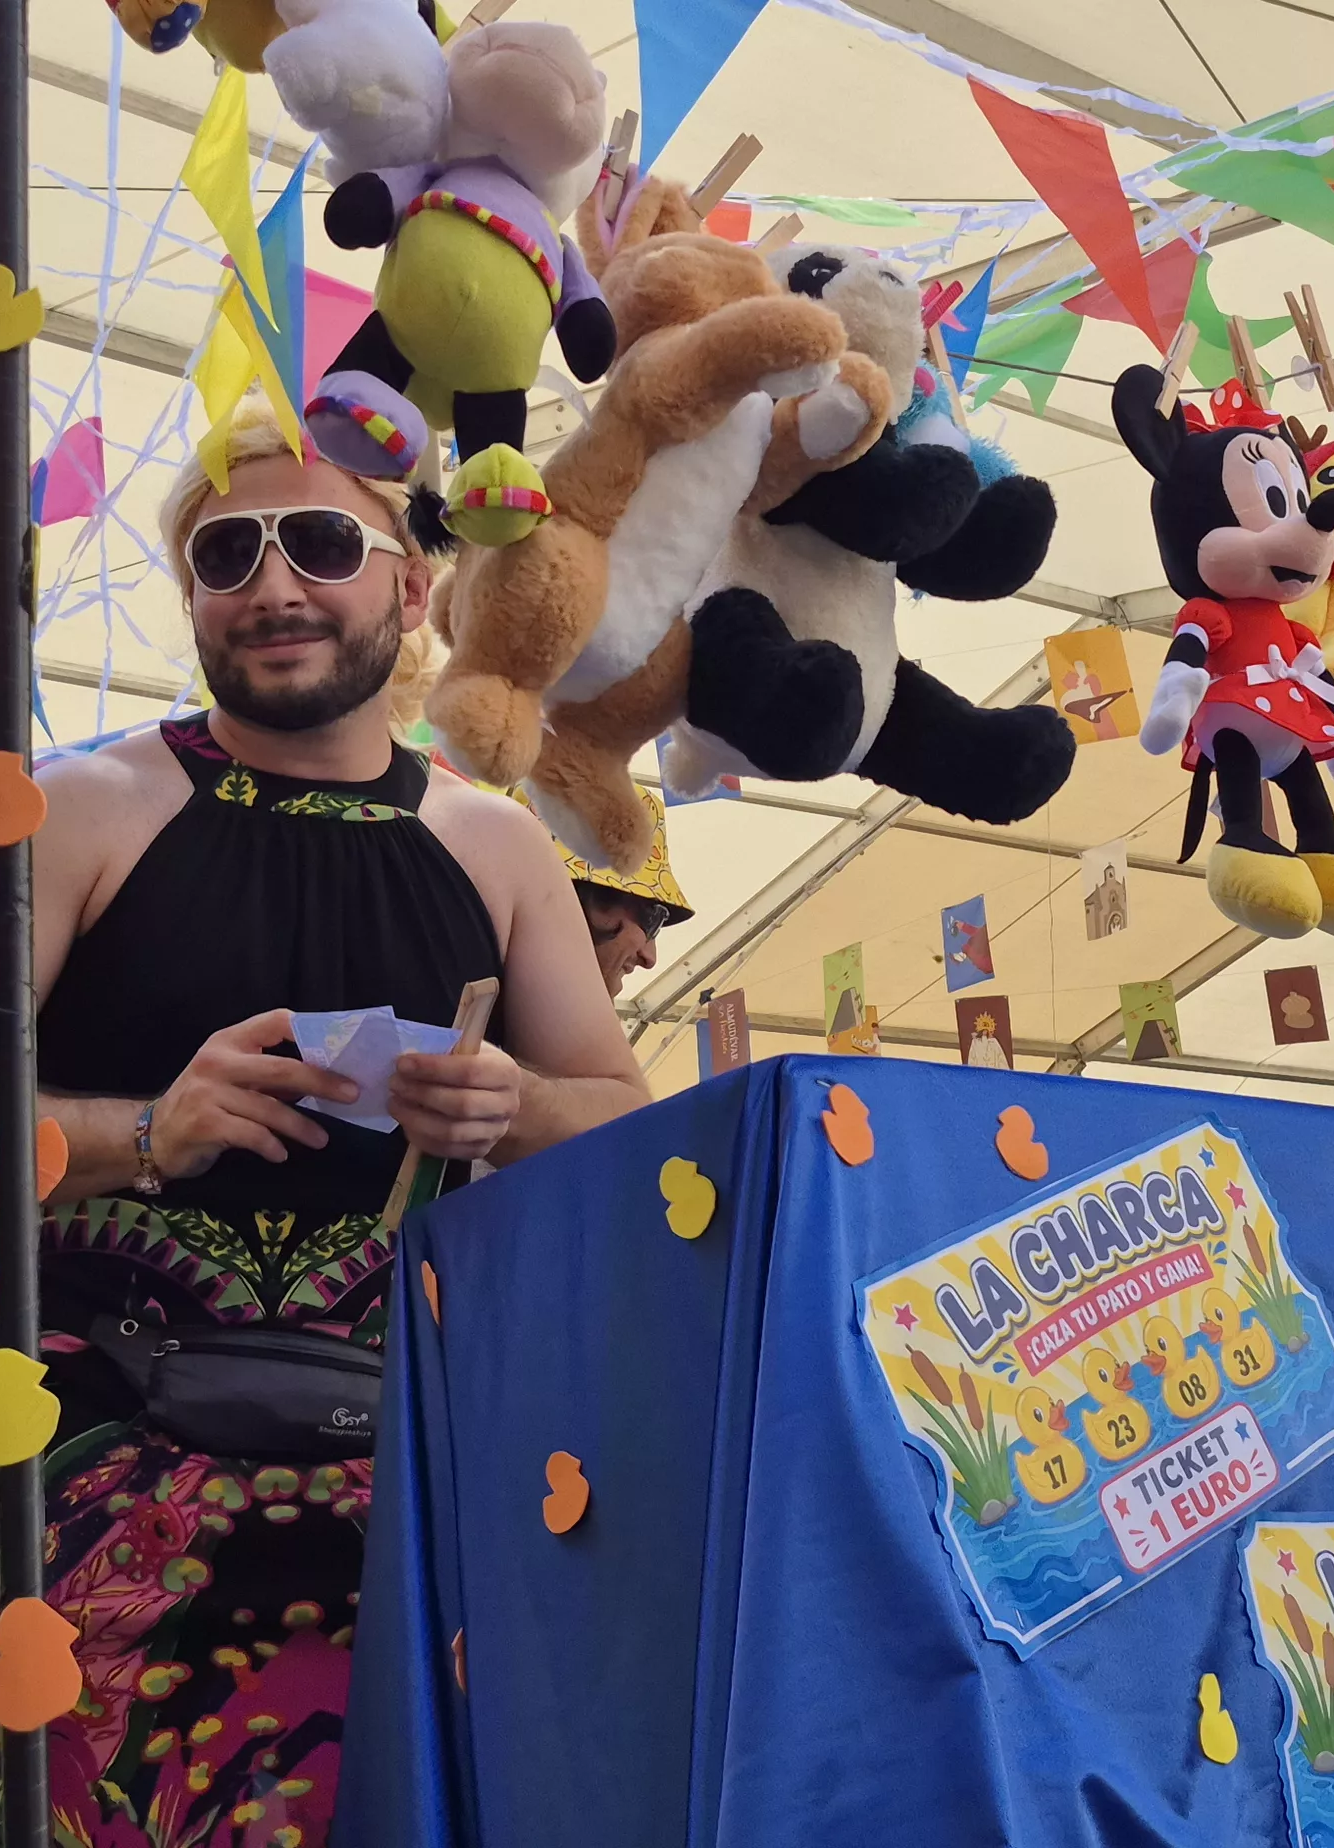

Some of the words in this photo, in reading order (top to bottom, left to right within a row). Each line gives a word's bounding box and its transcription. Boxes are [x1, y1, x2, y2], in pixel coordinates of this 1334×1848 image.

[935, 1257, 1030, 1365] LA
[1010, 1165, 1227, 1306] CHARCA
[1026, 1314, 1075, 1367] ¡CAZA
[1069, 1300, 1099, 1333] TU
[1095, 1278, 1143, 1320] PATO
[1138, 1271, 1155, 1296] Y
[1154, 1252, 1205, 1289] GANA!
[1232, 1343, 1261, 1377] 31
[1178, 1372, 1207, 1408] 08
[1107, 1413, 1137, 1449] 23
[1043, 1454, 1068, 1490] 17
[1131, 1424, 1231, 1505] TICKET
[1149, 1508, 1172, 1543] 1
[1170, 1458, 1252, 1531] EURO
